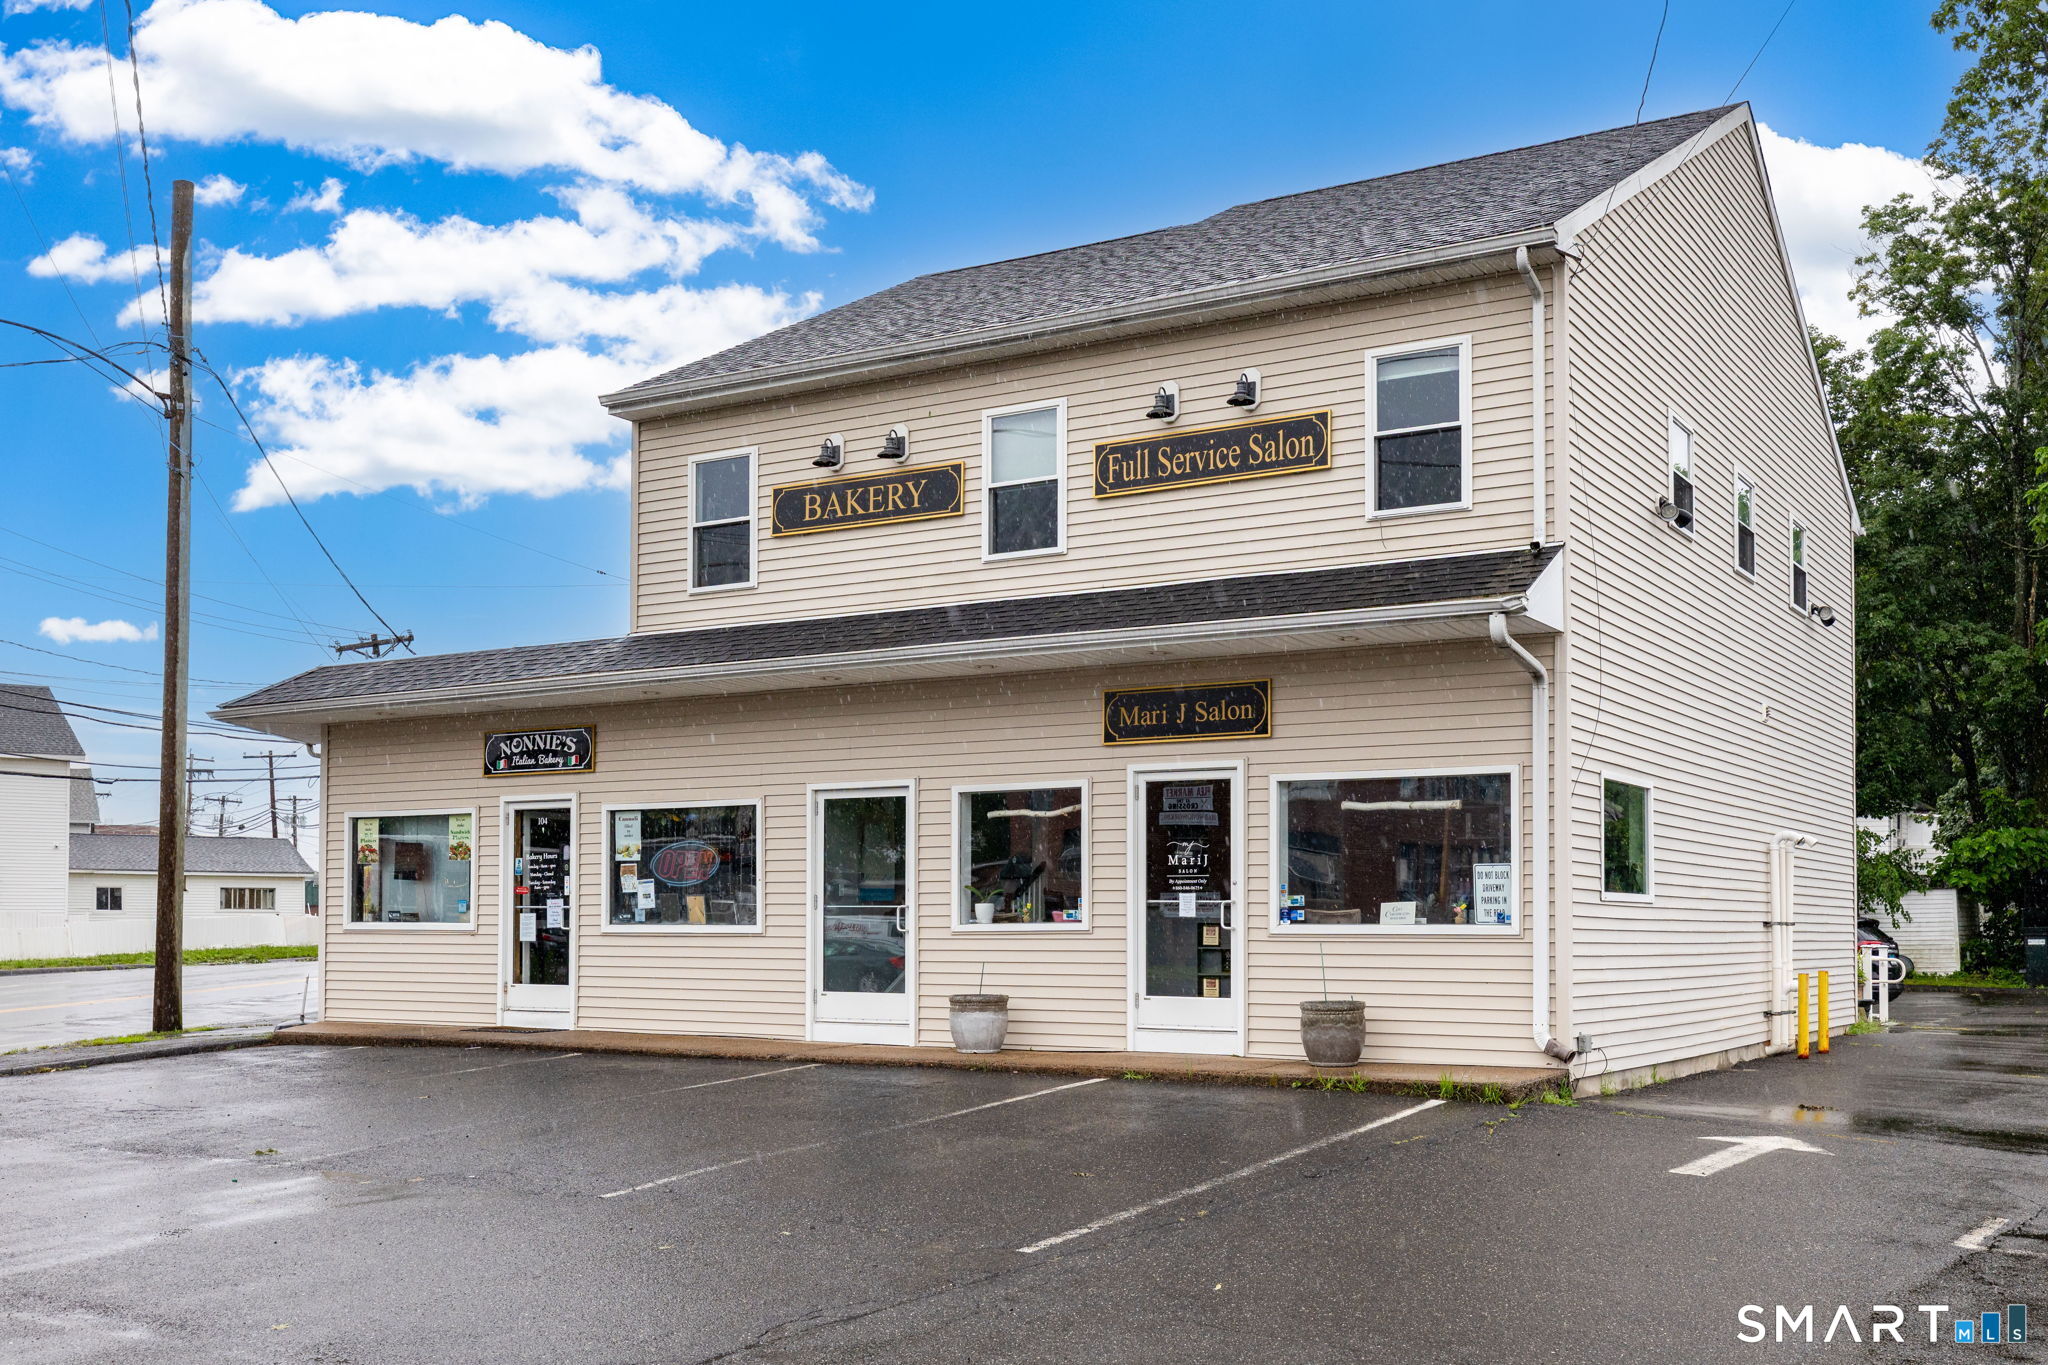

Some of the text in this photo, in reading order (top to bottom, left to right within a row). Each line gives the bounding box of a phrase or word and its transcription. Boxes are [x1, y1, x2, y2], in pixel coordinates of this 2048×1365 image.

[1107, 429, 1315, 483] Full Service Salon
[802, 479, 928, 522] BAKERY
[1119, 699, 1255, 727] Mari J Salon
[500, 734, 577, 758] NONNIE'S
[511, 752, 565, 768] Italian Bakery
[537, 817, 548, 826] 104
[657, 849, 713, 881] OPEN
[1477, 870, 1510, 880] DO NOT BLOCK
[1482, 883, 1505, 893] DRIVEWAY
[1481, 896, 1508, 905] PARKING IN
[1483, 908, 1493, 918] THE
